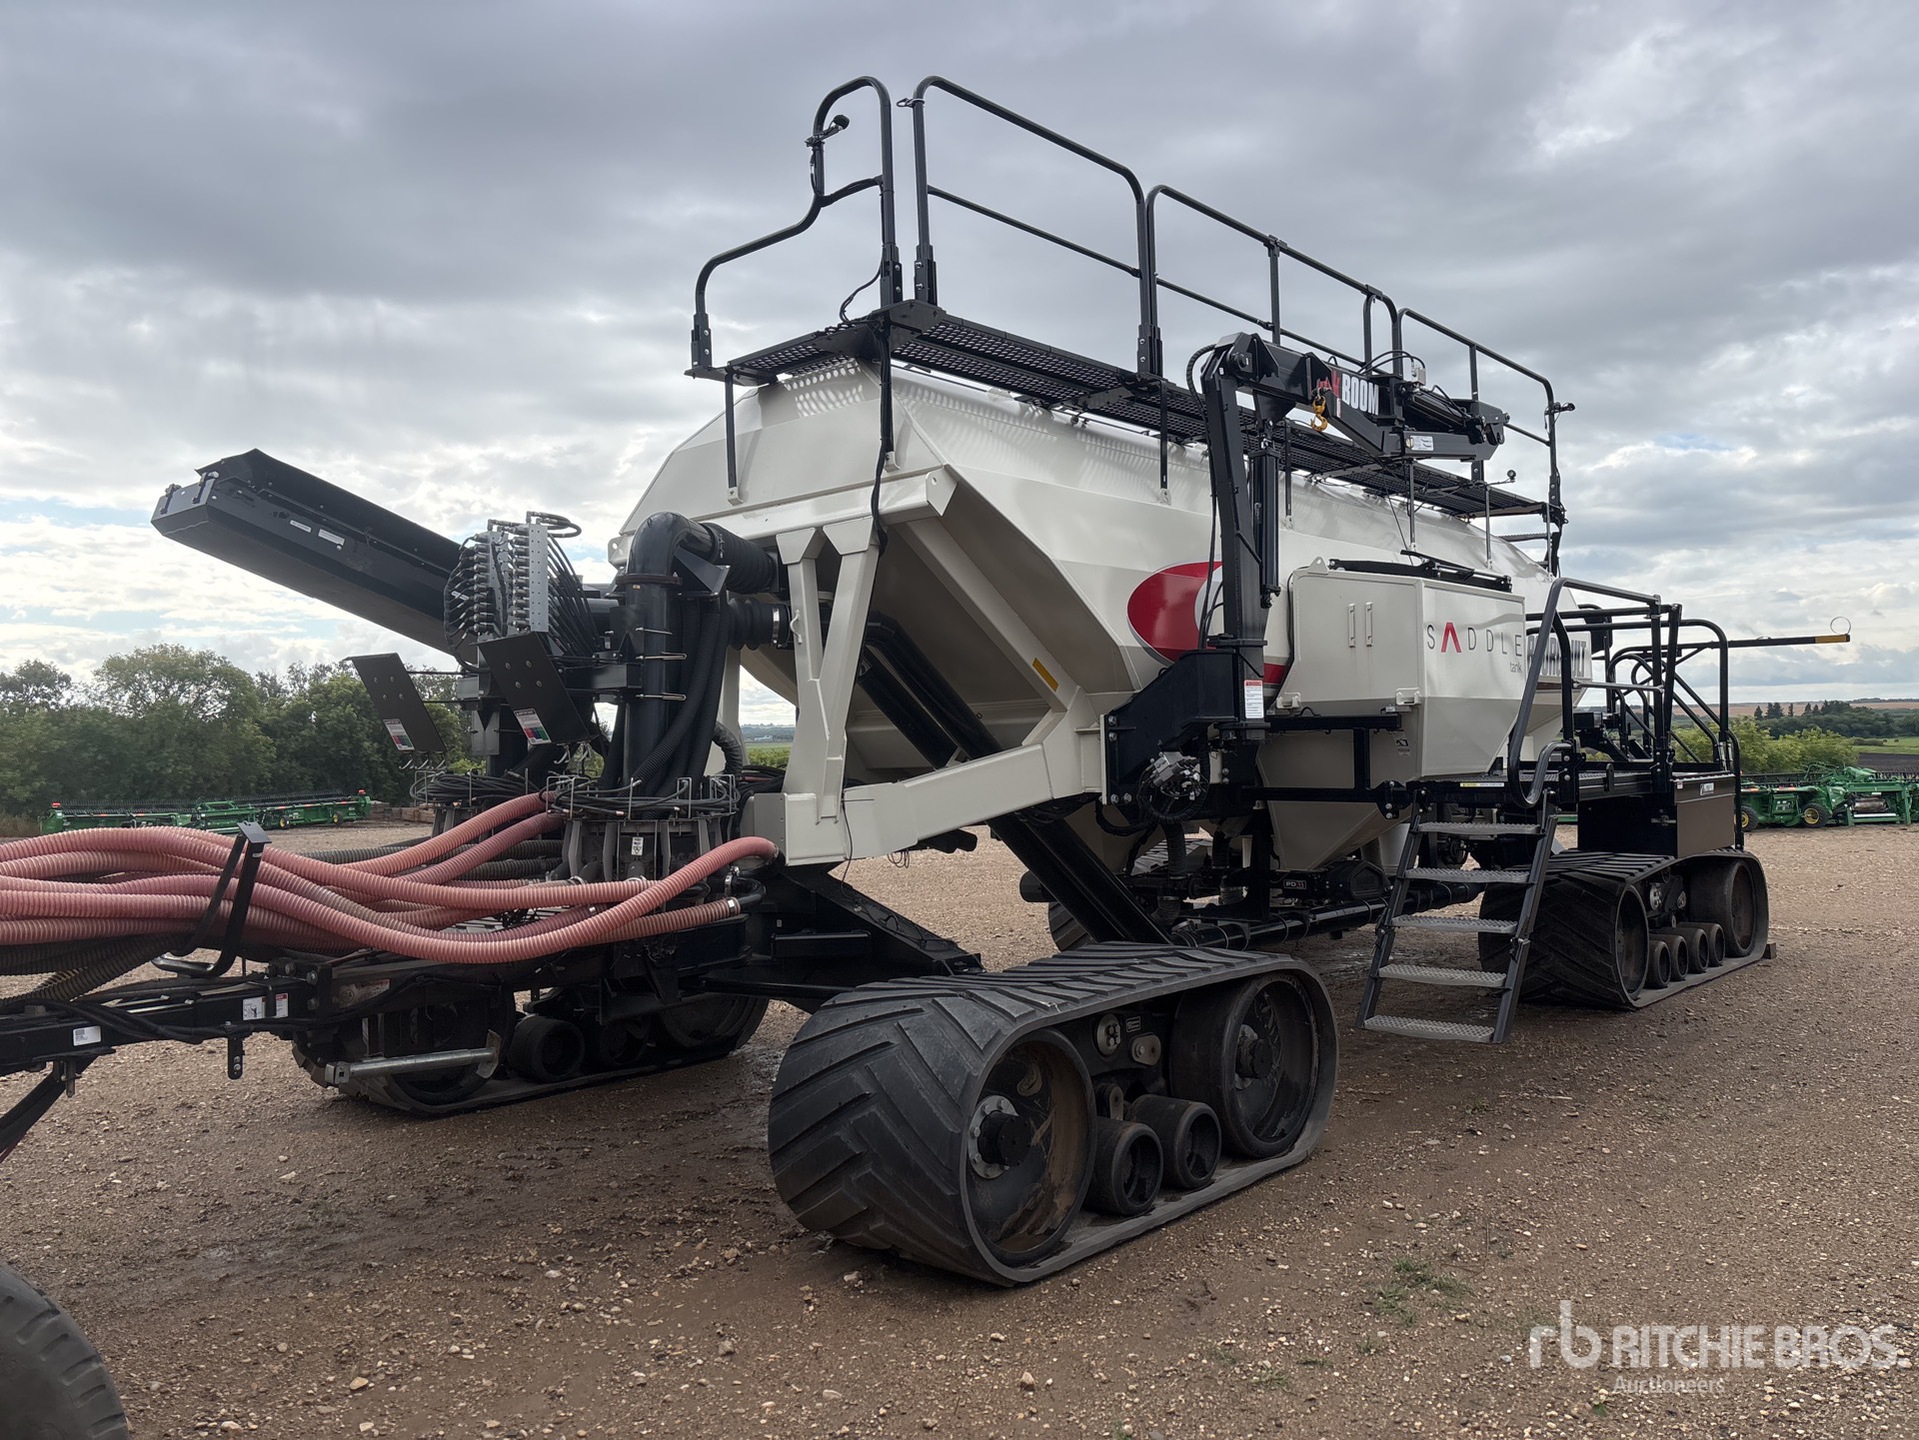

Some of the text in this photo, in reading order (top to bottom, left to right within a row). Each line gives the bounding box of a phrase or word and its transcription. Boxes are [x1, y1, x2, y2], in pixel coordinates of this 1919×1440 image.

[1342, 373, 1379, 416] BOOM
[1426, 622, 1522, 657] SADDLE
[1510, 661, 1523, 673] tank
